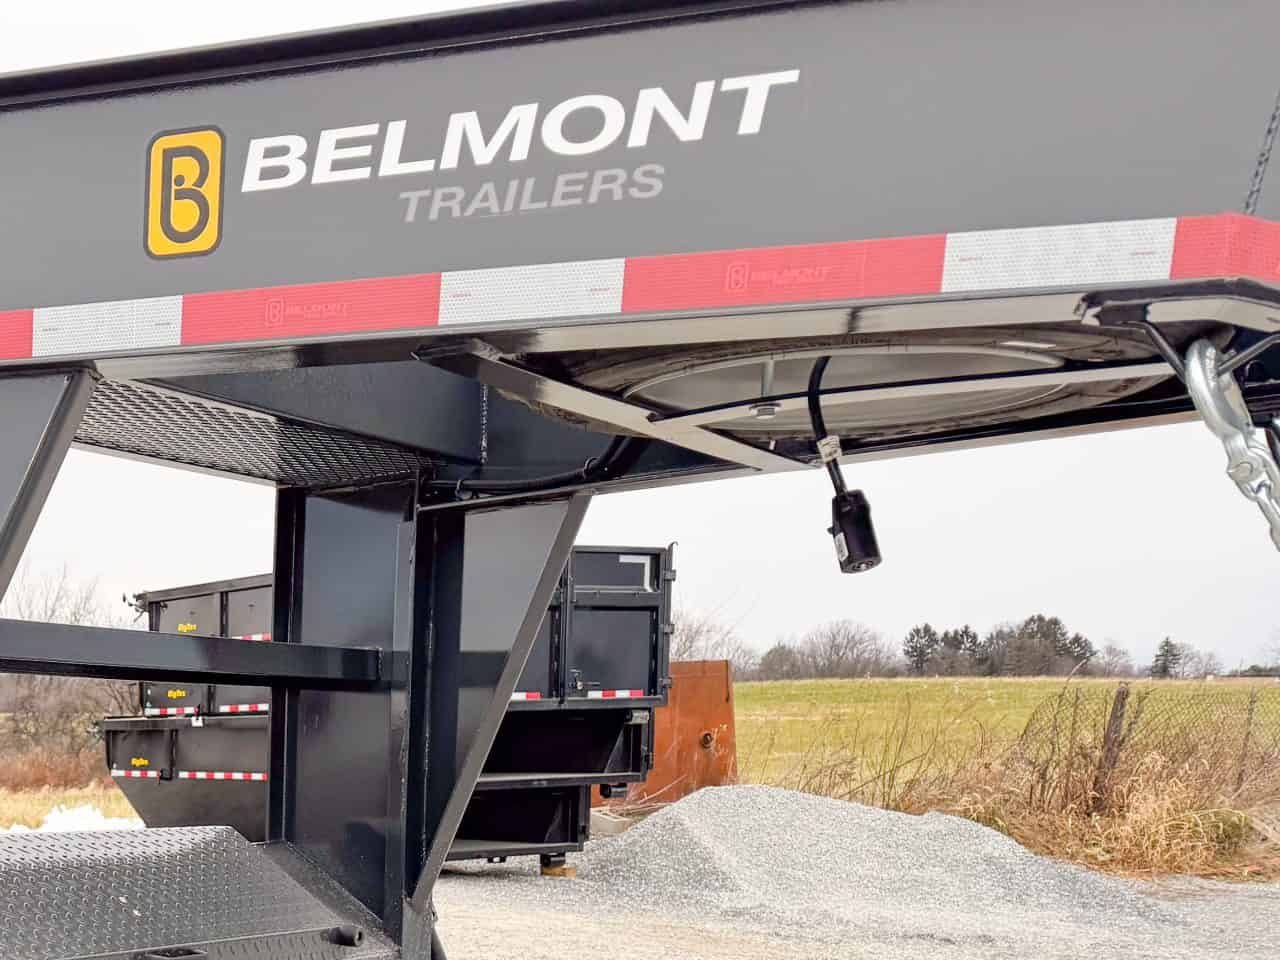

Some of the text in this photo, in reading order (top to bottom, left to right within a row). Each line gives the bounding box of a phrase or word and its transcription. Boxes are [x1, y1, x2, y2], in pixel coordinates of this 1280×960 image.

[160, 69, 800, 244] B BELMONT
[399, 163, 665, 223] TRAILERS
